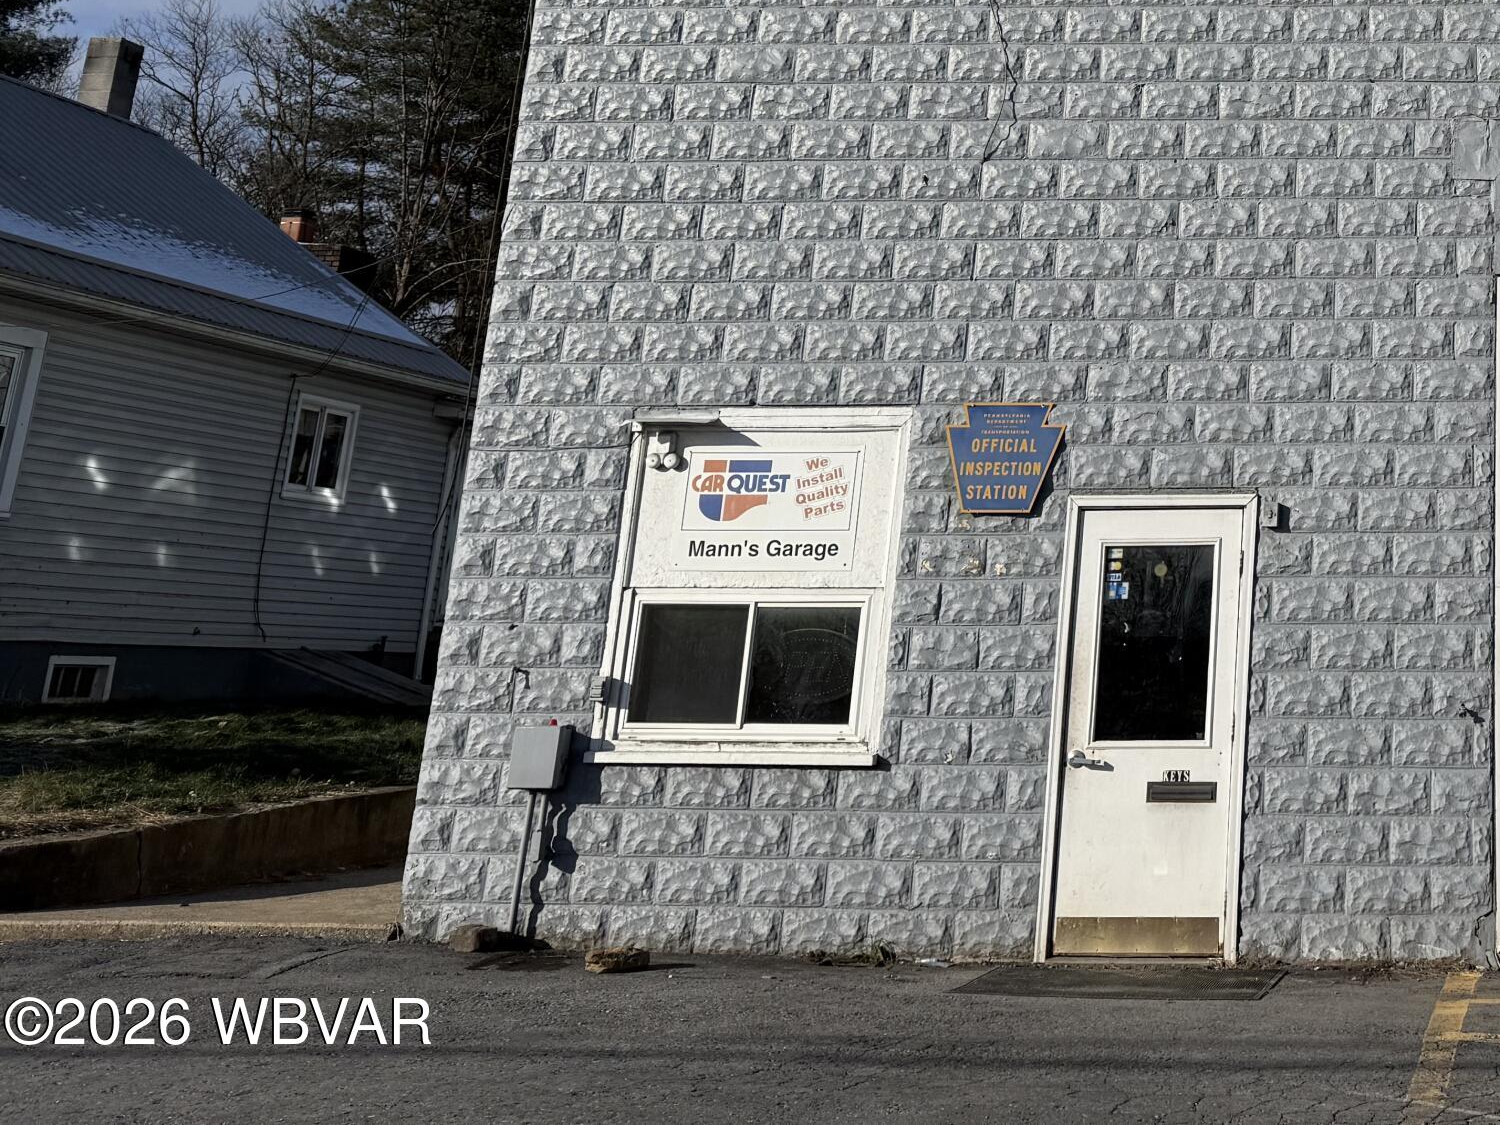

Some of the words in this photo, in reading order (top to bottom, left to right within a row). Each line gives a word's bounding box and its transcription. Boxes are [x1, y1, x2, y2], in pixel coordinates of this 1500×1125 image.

[971, 438, 1038, 453] OFFICIAL
[805, 457, 829, 471] We
[959, 461, 1042, 476] INSPECTION
[796, 467, 843, 489] Install
[795, 484, 848, 505] Quality
[965, 484, 1028, 500] STATION
[803, 501, 844, 519] Parts
[688, 539, 760, 557] Mann's
[766, 539, 839, 561] Garage
[1163, 770, 1190, 782] KEYS
